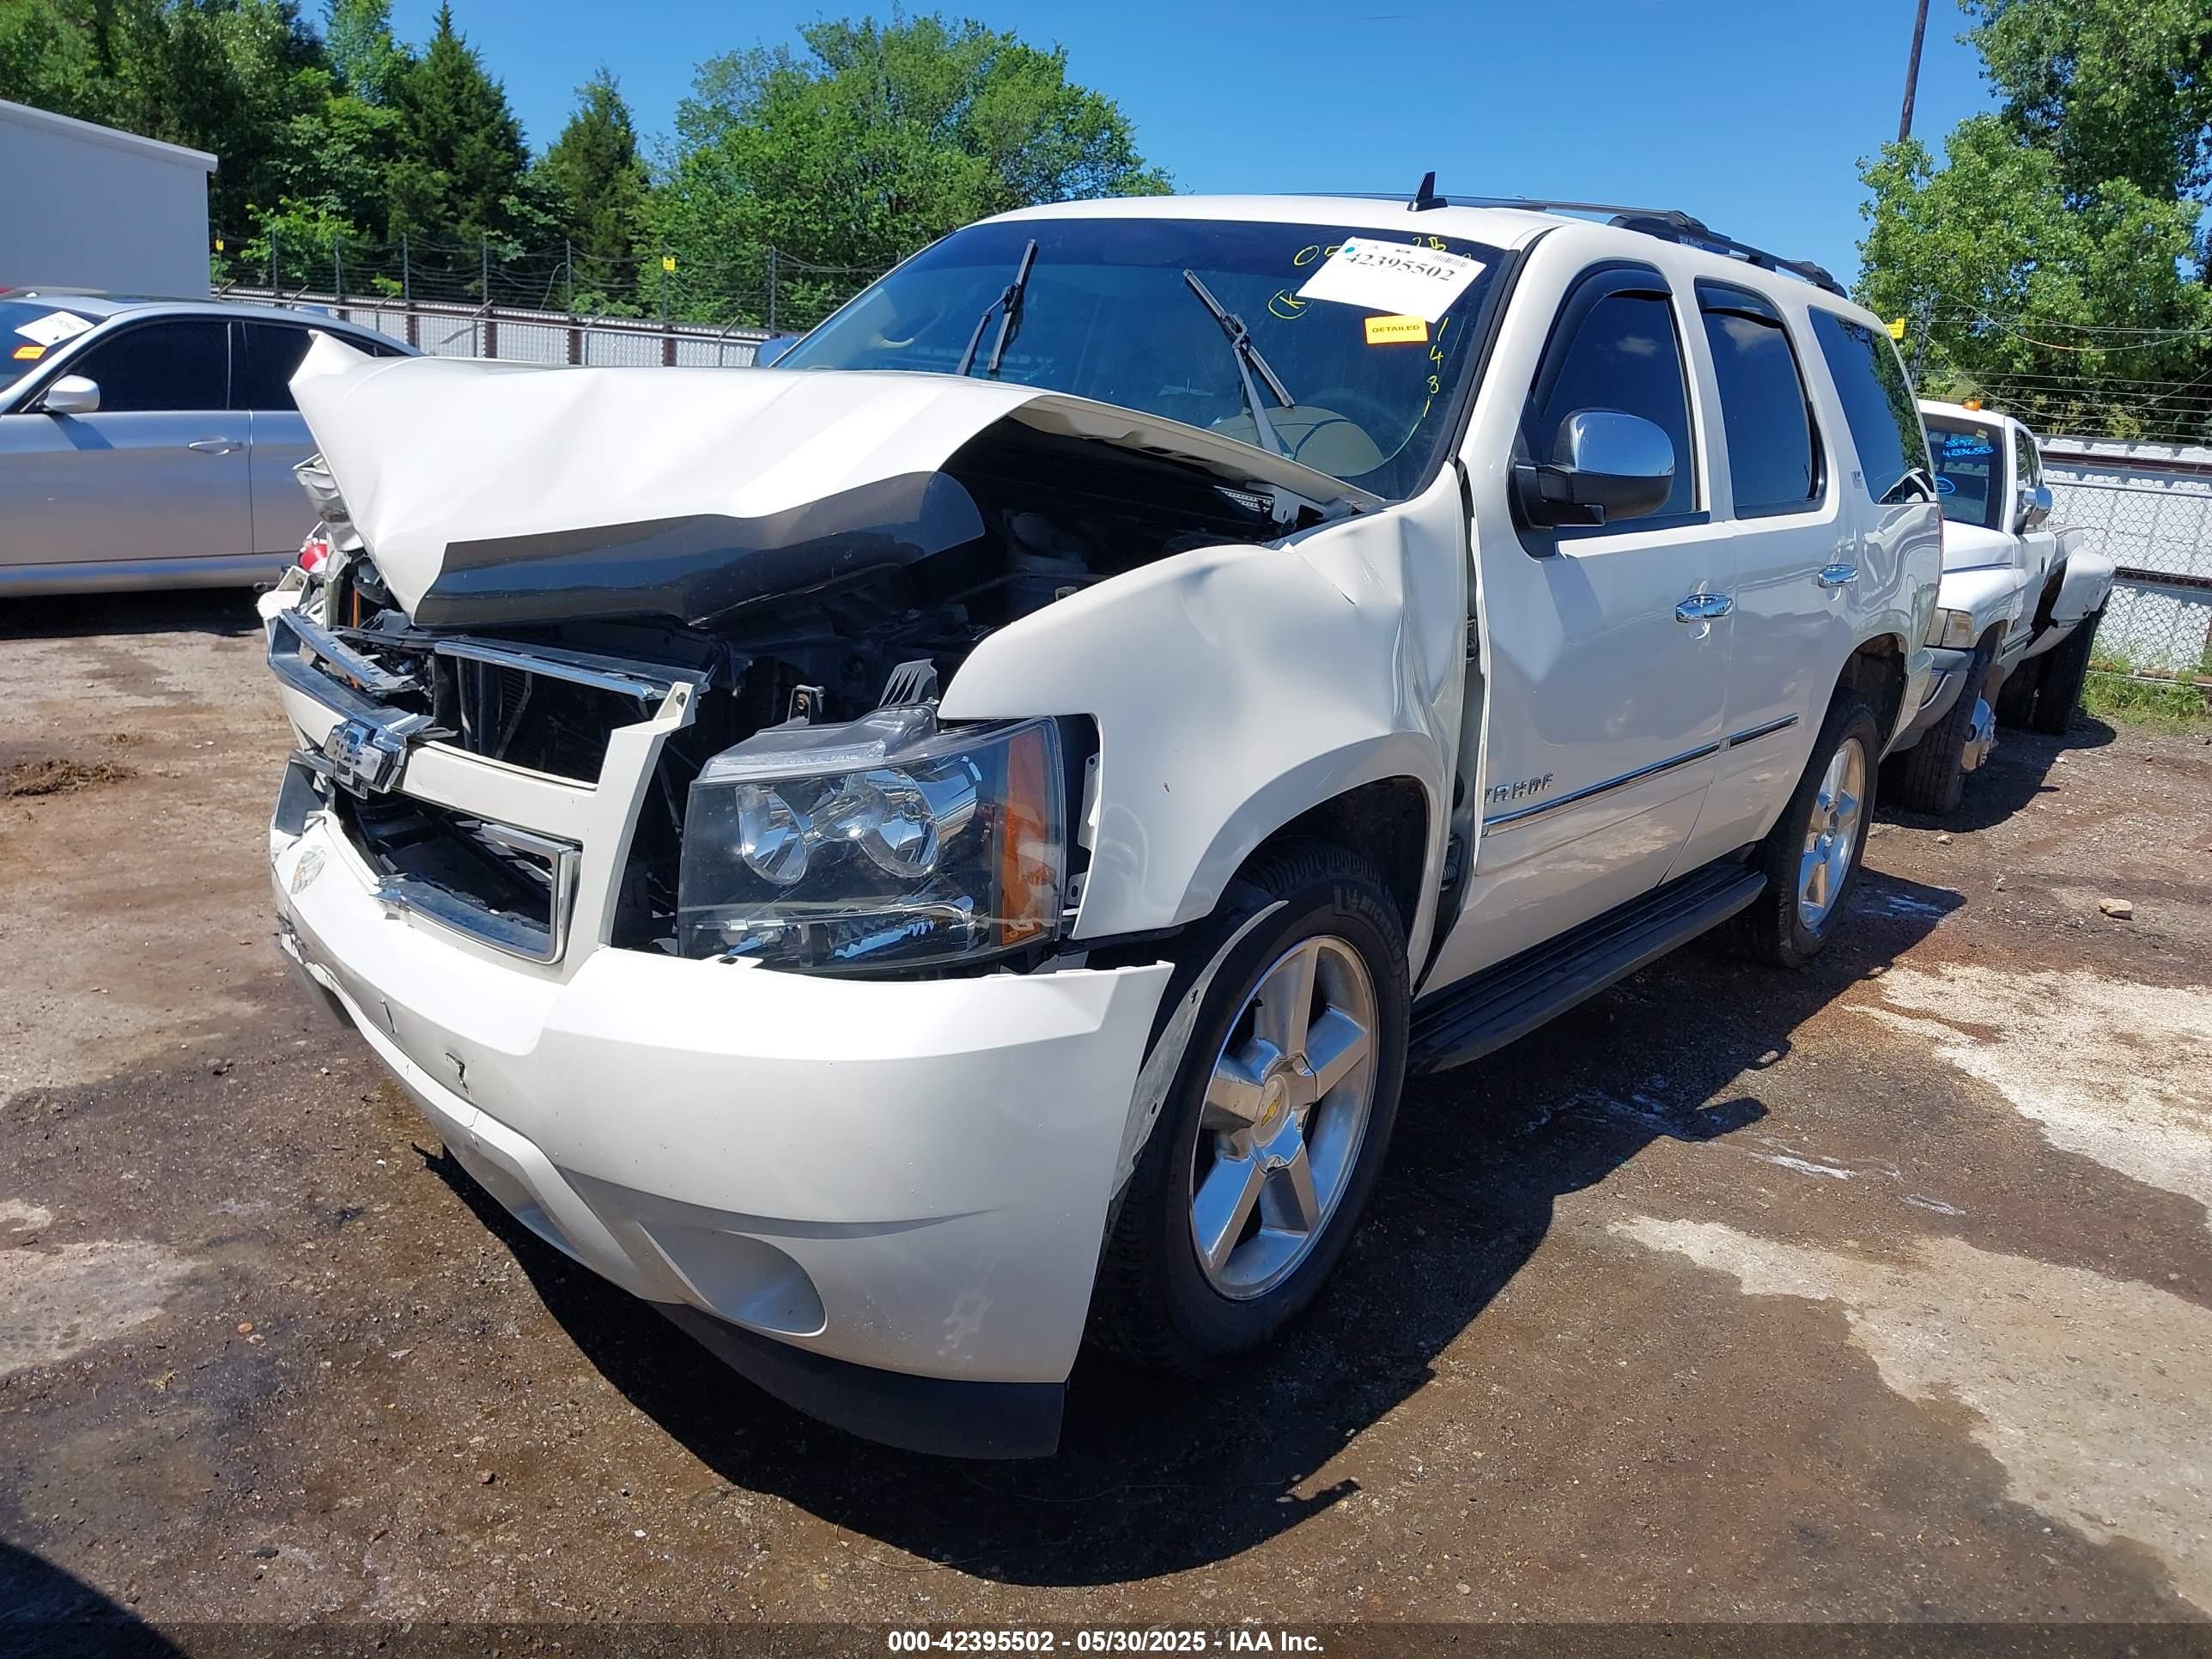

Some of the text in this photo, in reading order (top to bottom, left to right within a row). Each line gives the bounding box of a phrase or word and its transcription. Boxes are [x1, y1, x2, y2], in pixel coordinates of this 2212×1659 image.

[1346, 253, 1455, 281] 42395502
[1372, 325, 1419, 333] DETAILED
[1485, 772, 1554, 804] TAHOE
